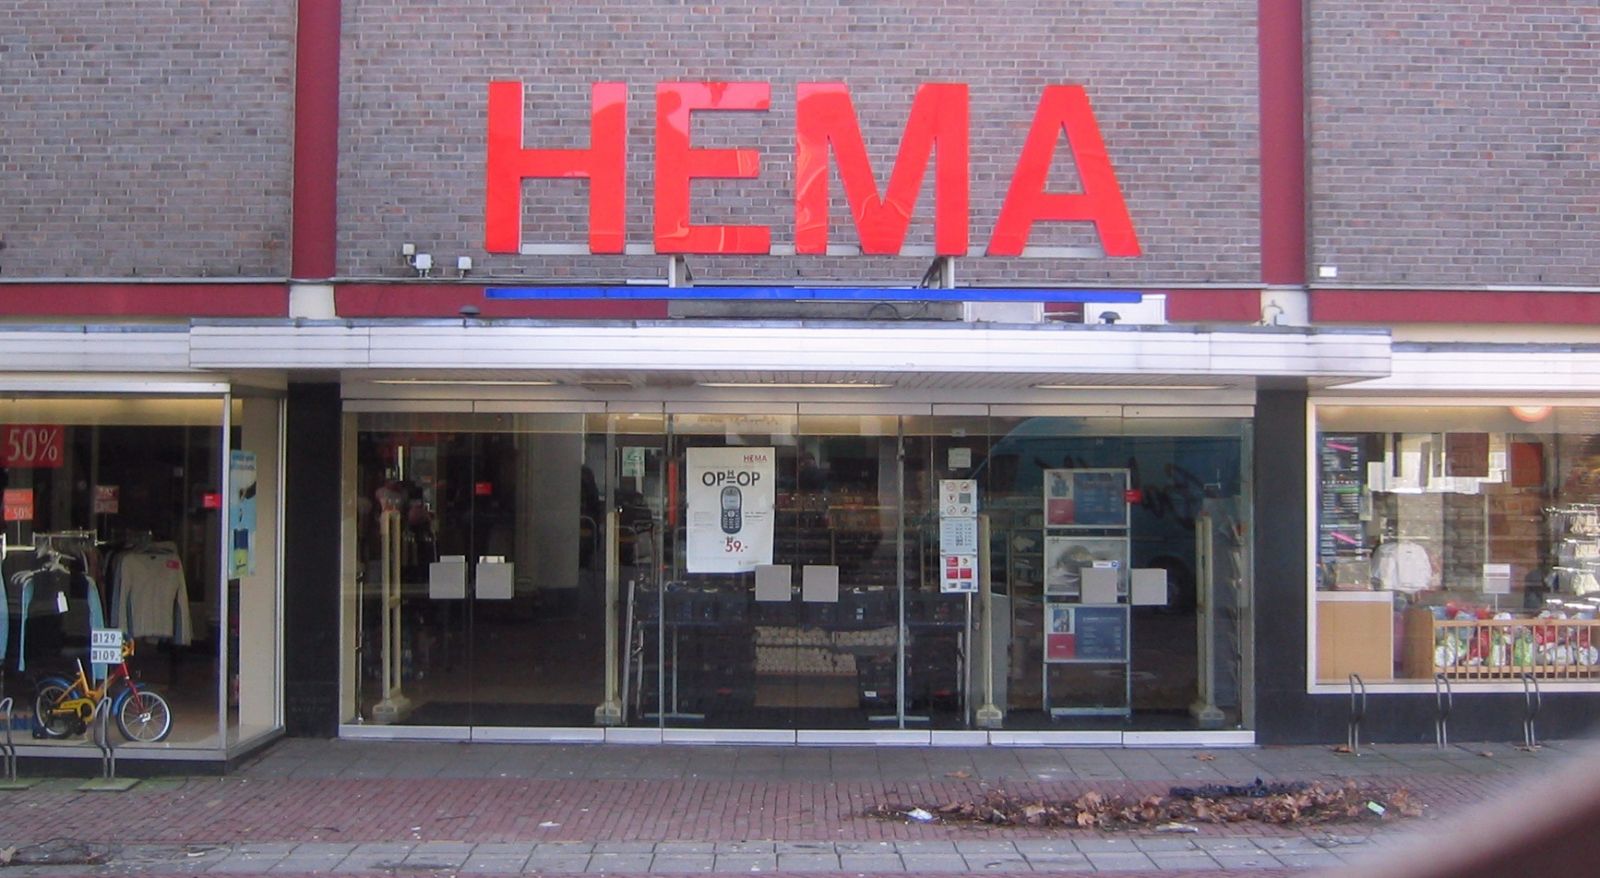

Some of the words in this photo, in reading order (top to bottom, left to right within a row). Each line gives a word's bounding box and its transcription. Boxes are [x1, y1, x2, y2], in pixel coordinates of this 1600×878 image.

[486, 82, 1142, 256] HEMA
[8, 428, 58, 461] 50%
[743, 454, 768, 463] HEMA
